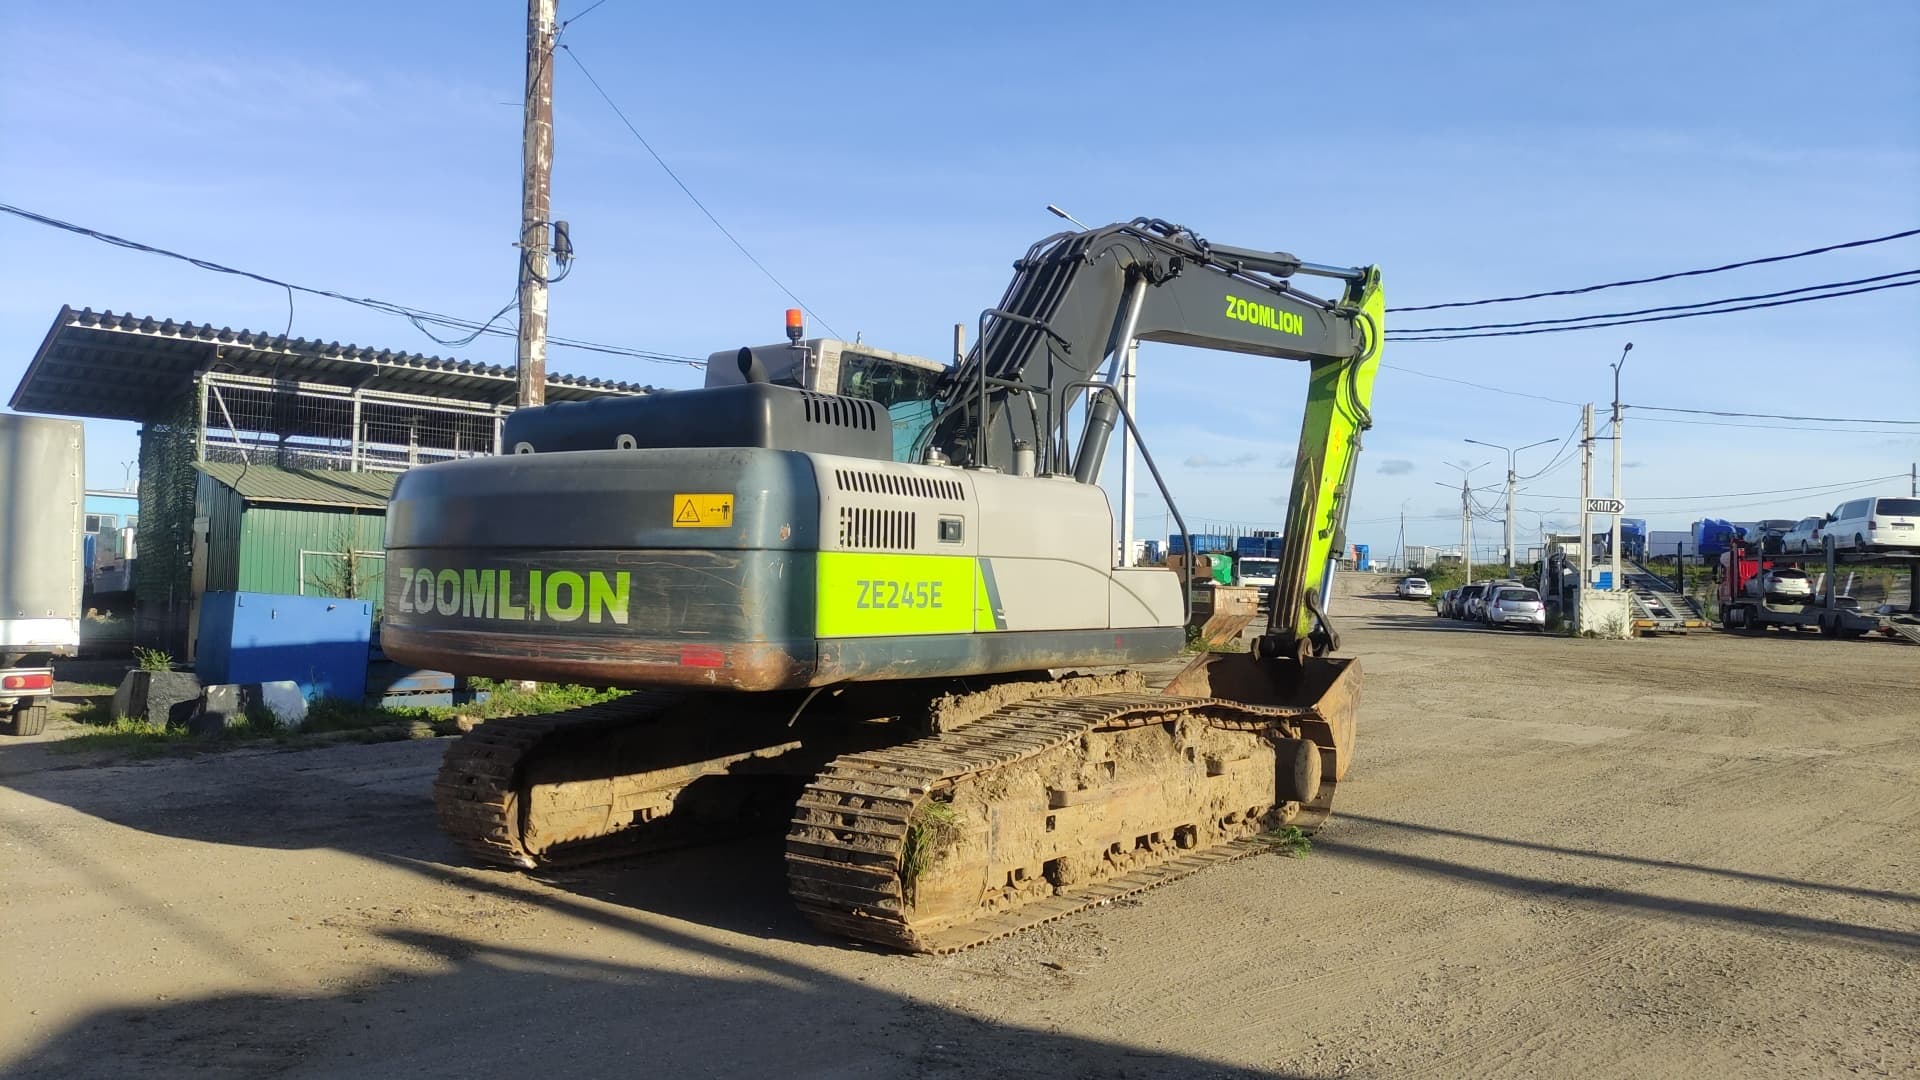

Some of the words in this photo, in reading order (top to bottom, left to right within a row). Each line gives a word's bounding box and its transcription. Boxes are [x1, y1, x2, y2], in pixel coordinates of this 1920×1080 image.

[1225, 295, 1304, 336] ZOOMLION
[398, 567, 631, 625] ZOOMLION
[856, 580, 943, 608] ZE245E
